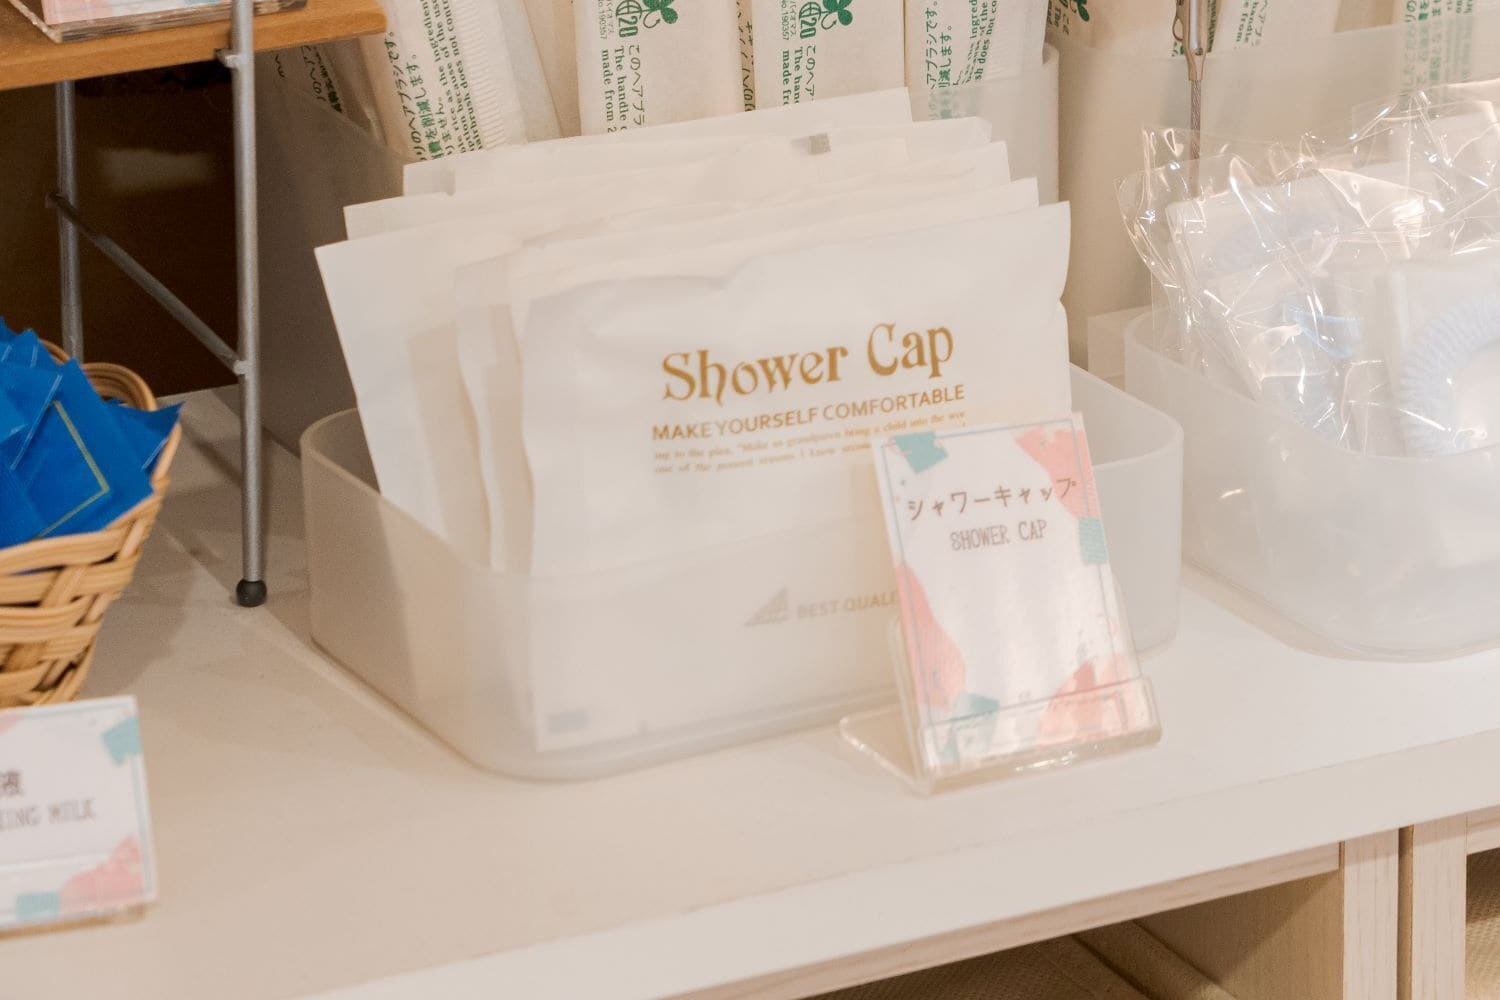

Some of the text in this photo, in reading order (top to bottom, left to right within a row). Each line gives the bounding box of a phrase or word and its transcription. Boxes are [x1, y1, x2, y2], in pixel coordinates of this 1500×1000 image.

[975, 2, 988, 20] the
[435, 23, 446, 42] the
[448, 36, 460, 56] not
[976, 39, 990, 64] does
[984, 17, 996, 35] not
[439, 46, 450, 59] of
[601, 50, 614, 85] made
[782, 50, 793, 85] made
[794, 47, 804, 71] The
[438, 66, 449, 86] the
[447, 63, 463, 113] because
[456, 60, 468, 88] does
[614, 46, 629, 121] The handle
[445, 90, 454, 103] as
[603, 90, 616, 121] from
[662, 323, 954, 407] Shower Cap
[652, 422, 711, 440] MAKE
[715, 406, 818, 435] YOURSELF
[823, 384, 964, 420] COMFORTABLE
[907, 478, 1077, 521] シャワーキャップ
[949, 519, 1047, 552] SHOWER CAP
[798, 600, 838, 618] BEST
